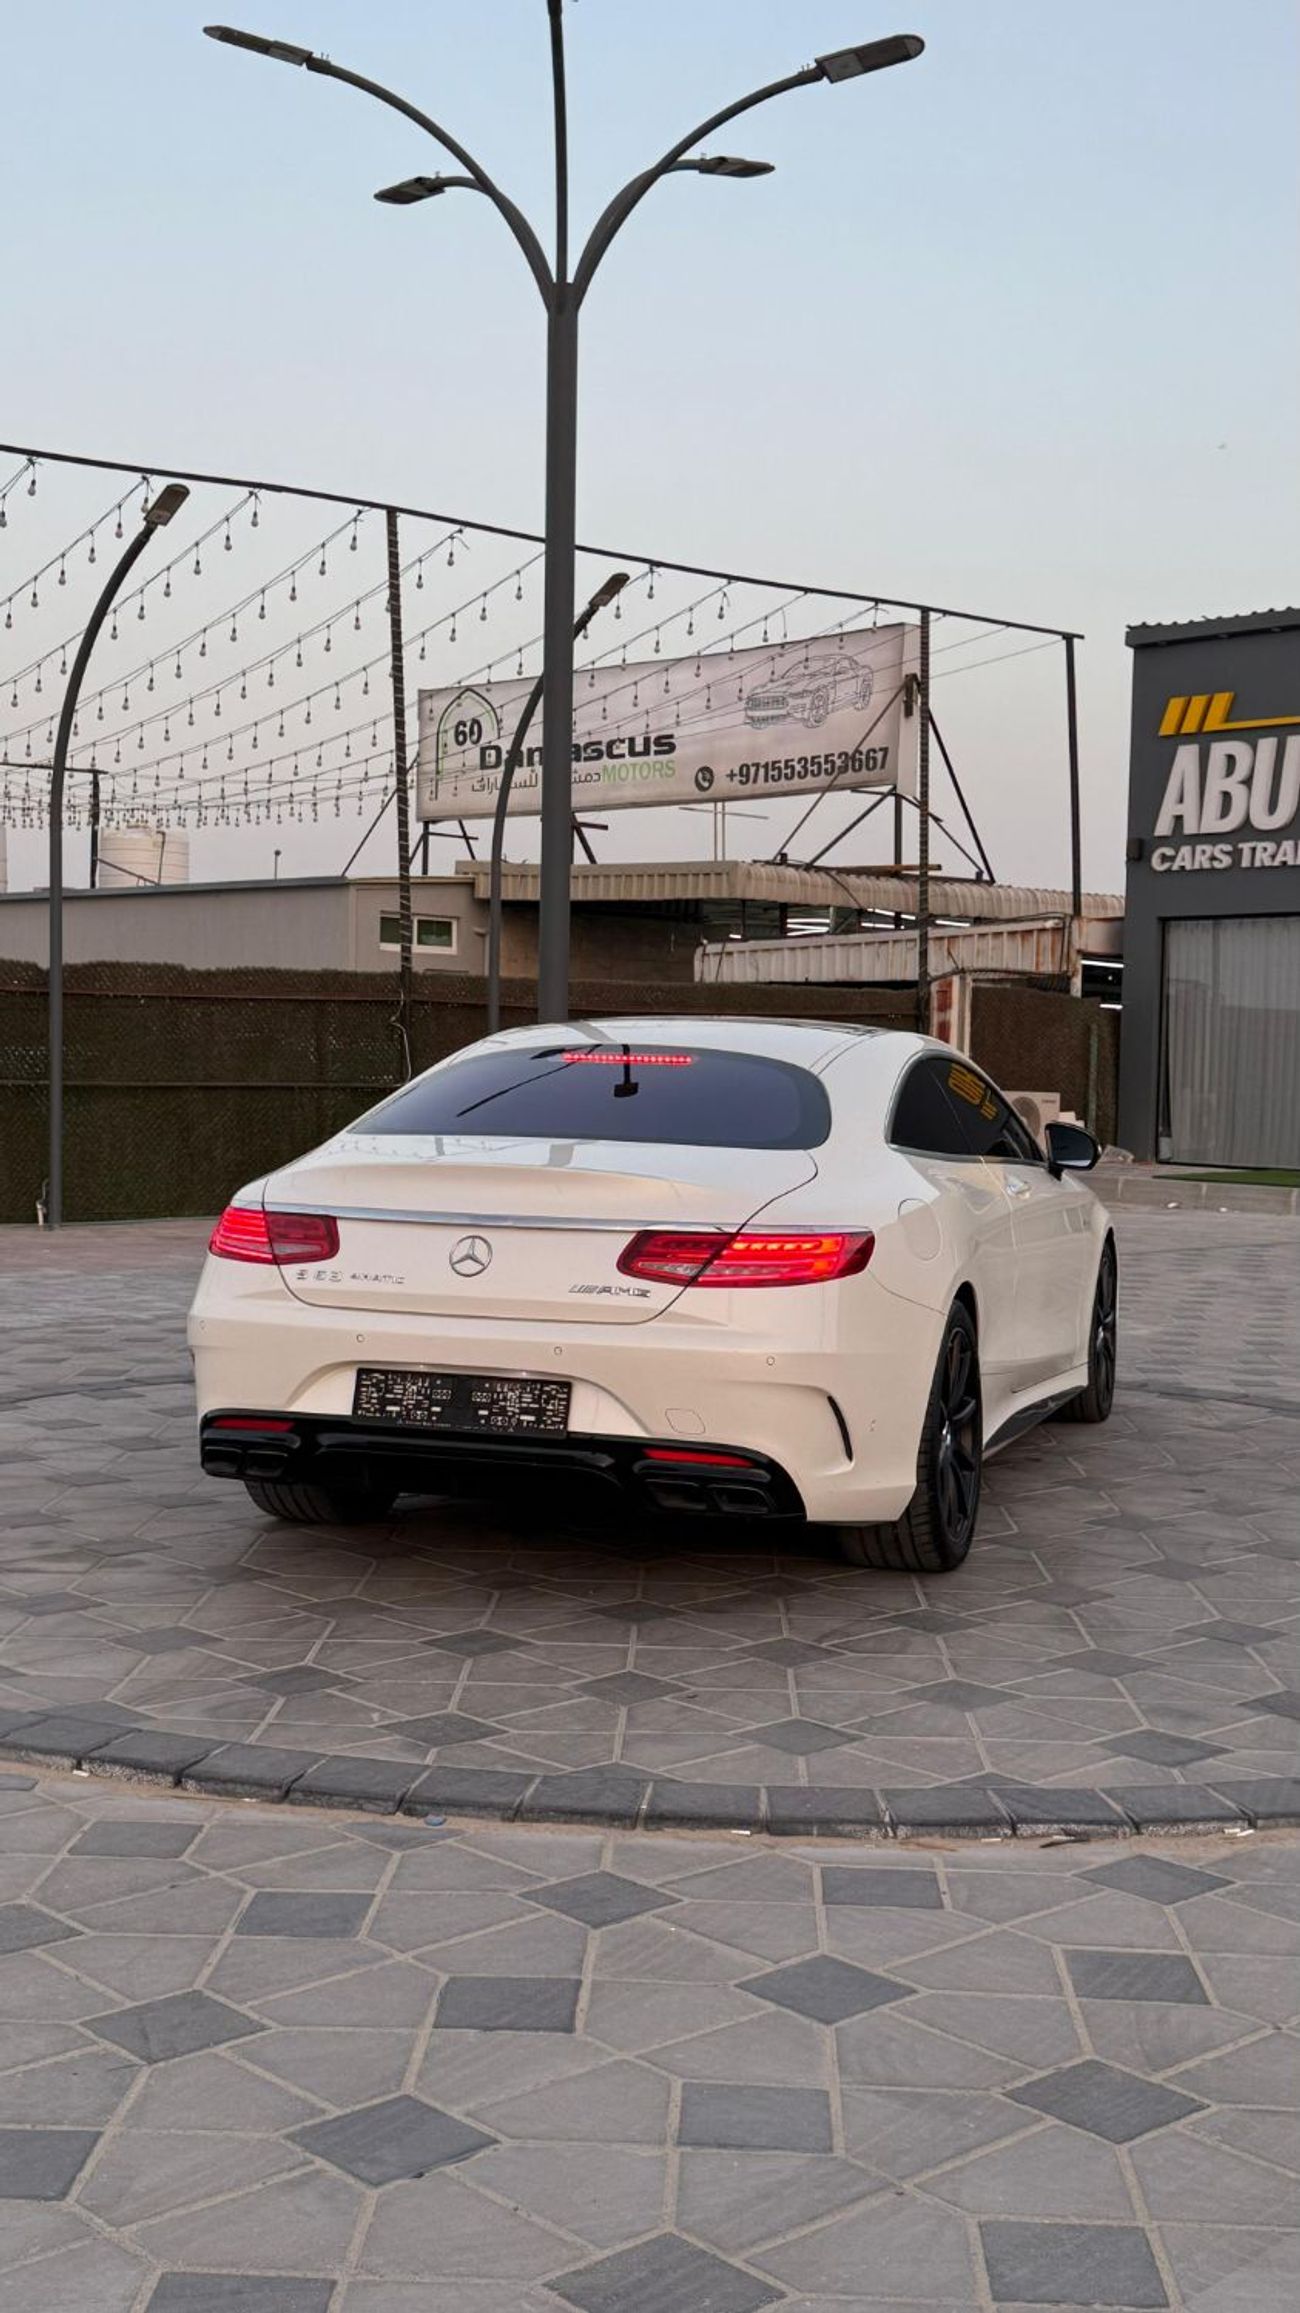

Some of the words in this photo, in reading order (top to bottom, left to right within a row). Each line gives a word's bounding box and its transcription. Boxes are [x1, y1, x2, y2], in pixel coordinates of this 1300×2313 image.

[454, 718, 482, 747] 60
[602, 759, 677, 784] MOTORS
[725, 747, 889, 786] +971553553667
[471, 772, 539, 795] للسارات
[1154, 734, 1300, 837] ABU
[1151, 842, 1232, 872] CARS
[1238, 840, 1300, 868] TRA
